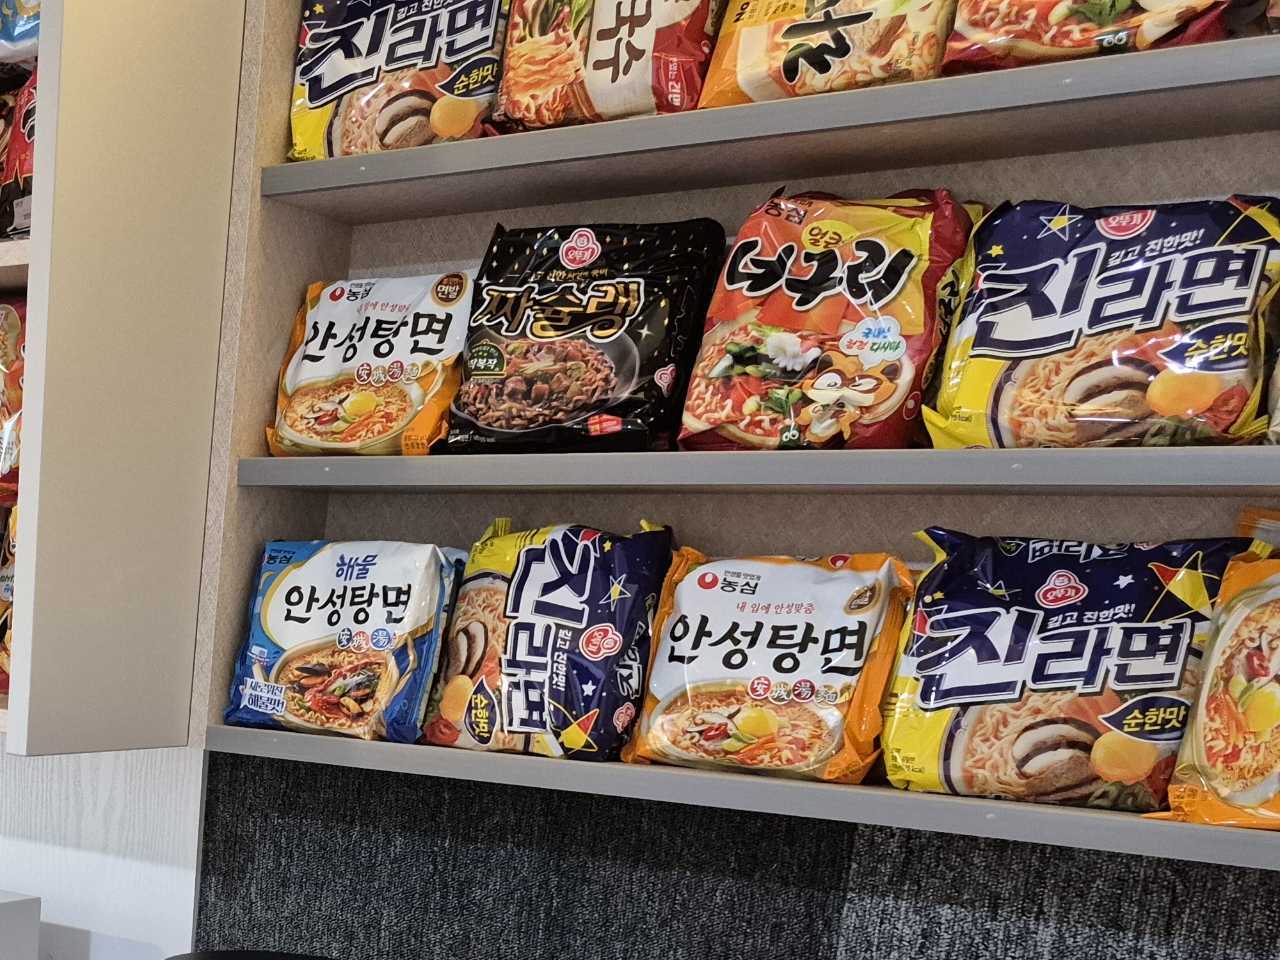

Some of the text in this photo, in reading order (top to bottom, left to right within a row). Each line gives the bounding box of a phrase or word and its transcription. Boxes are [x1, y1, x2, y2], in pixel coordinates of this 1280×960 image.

[298, 0, 501, 108] 진라면
[453, 62, 498, 94] 순한맛
[1108, 211, 1144, 228] 오뚜기
[1144, 228, 1206, 255] 진한맛!
[724, 237, 920, 311] 너구리
[471, 278, 645, 343] 짜슐랭
[969, 241, 1268, 360] 진라면
[301, 311, 454, 364] 안성탕면
[1184, 332, 1249, 364] 순한맛
[334, 553, 379, 582] 해물
[720, 577, 759, 596] 농심
[283, 582, 413, 627] 안성탕면
[736, 602, 817, 615] 내 입에 안성맞춤
[1046, 586, 1078, 600] 오뚜기
[501, 534, 595, 733] 진라면
[1047, 603, 1137, 630] 깊고 진한맛!
[668, 614, 868, 677] 안성탕면
[915, 605, 1194, 711] 진라면
[552, 652, 571, 692] 진한맛!
[470, 693, 490, 738] 순한맛
[1122, 707, 1188, 734] 순한맛
